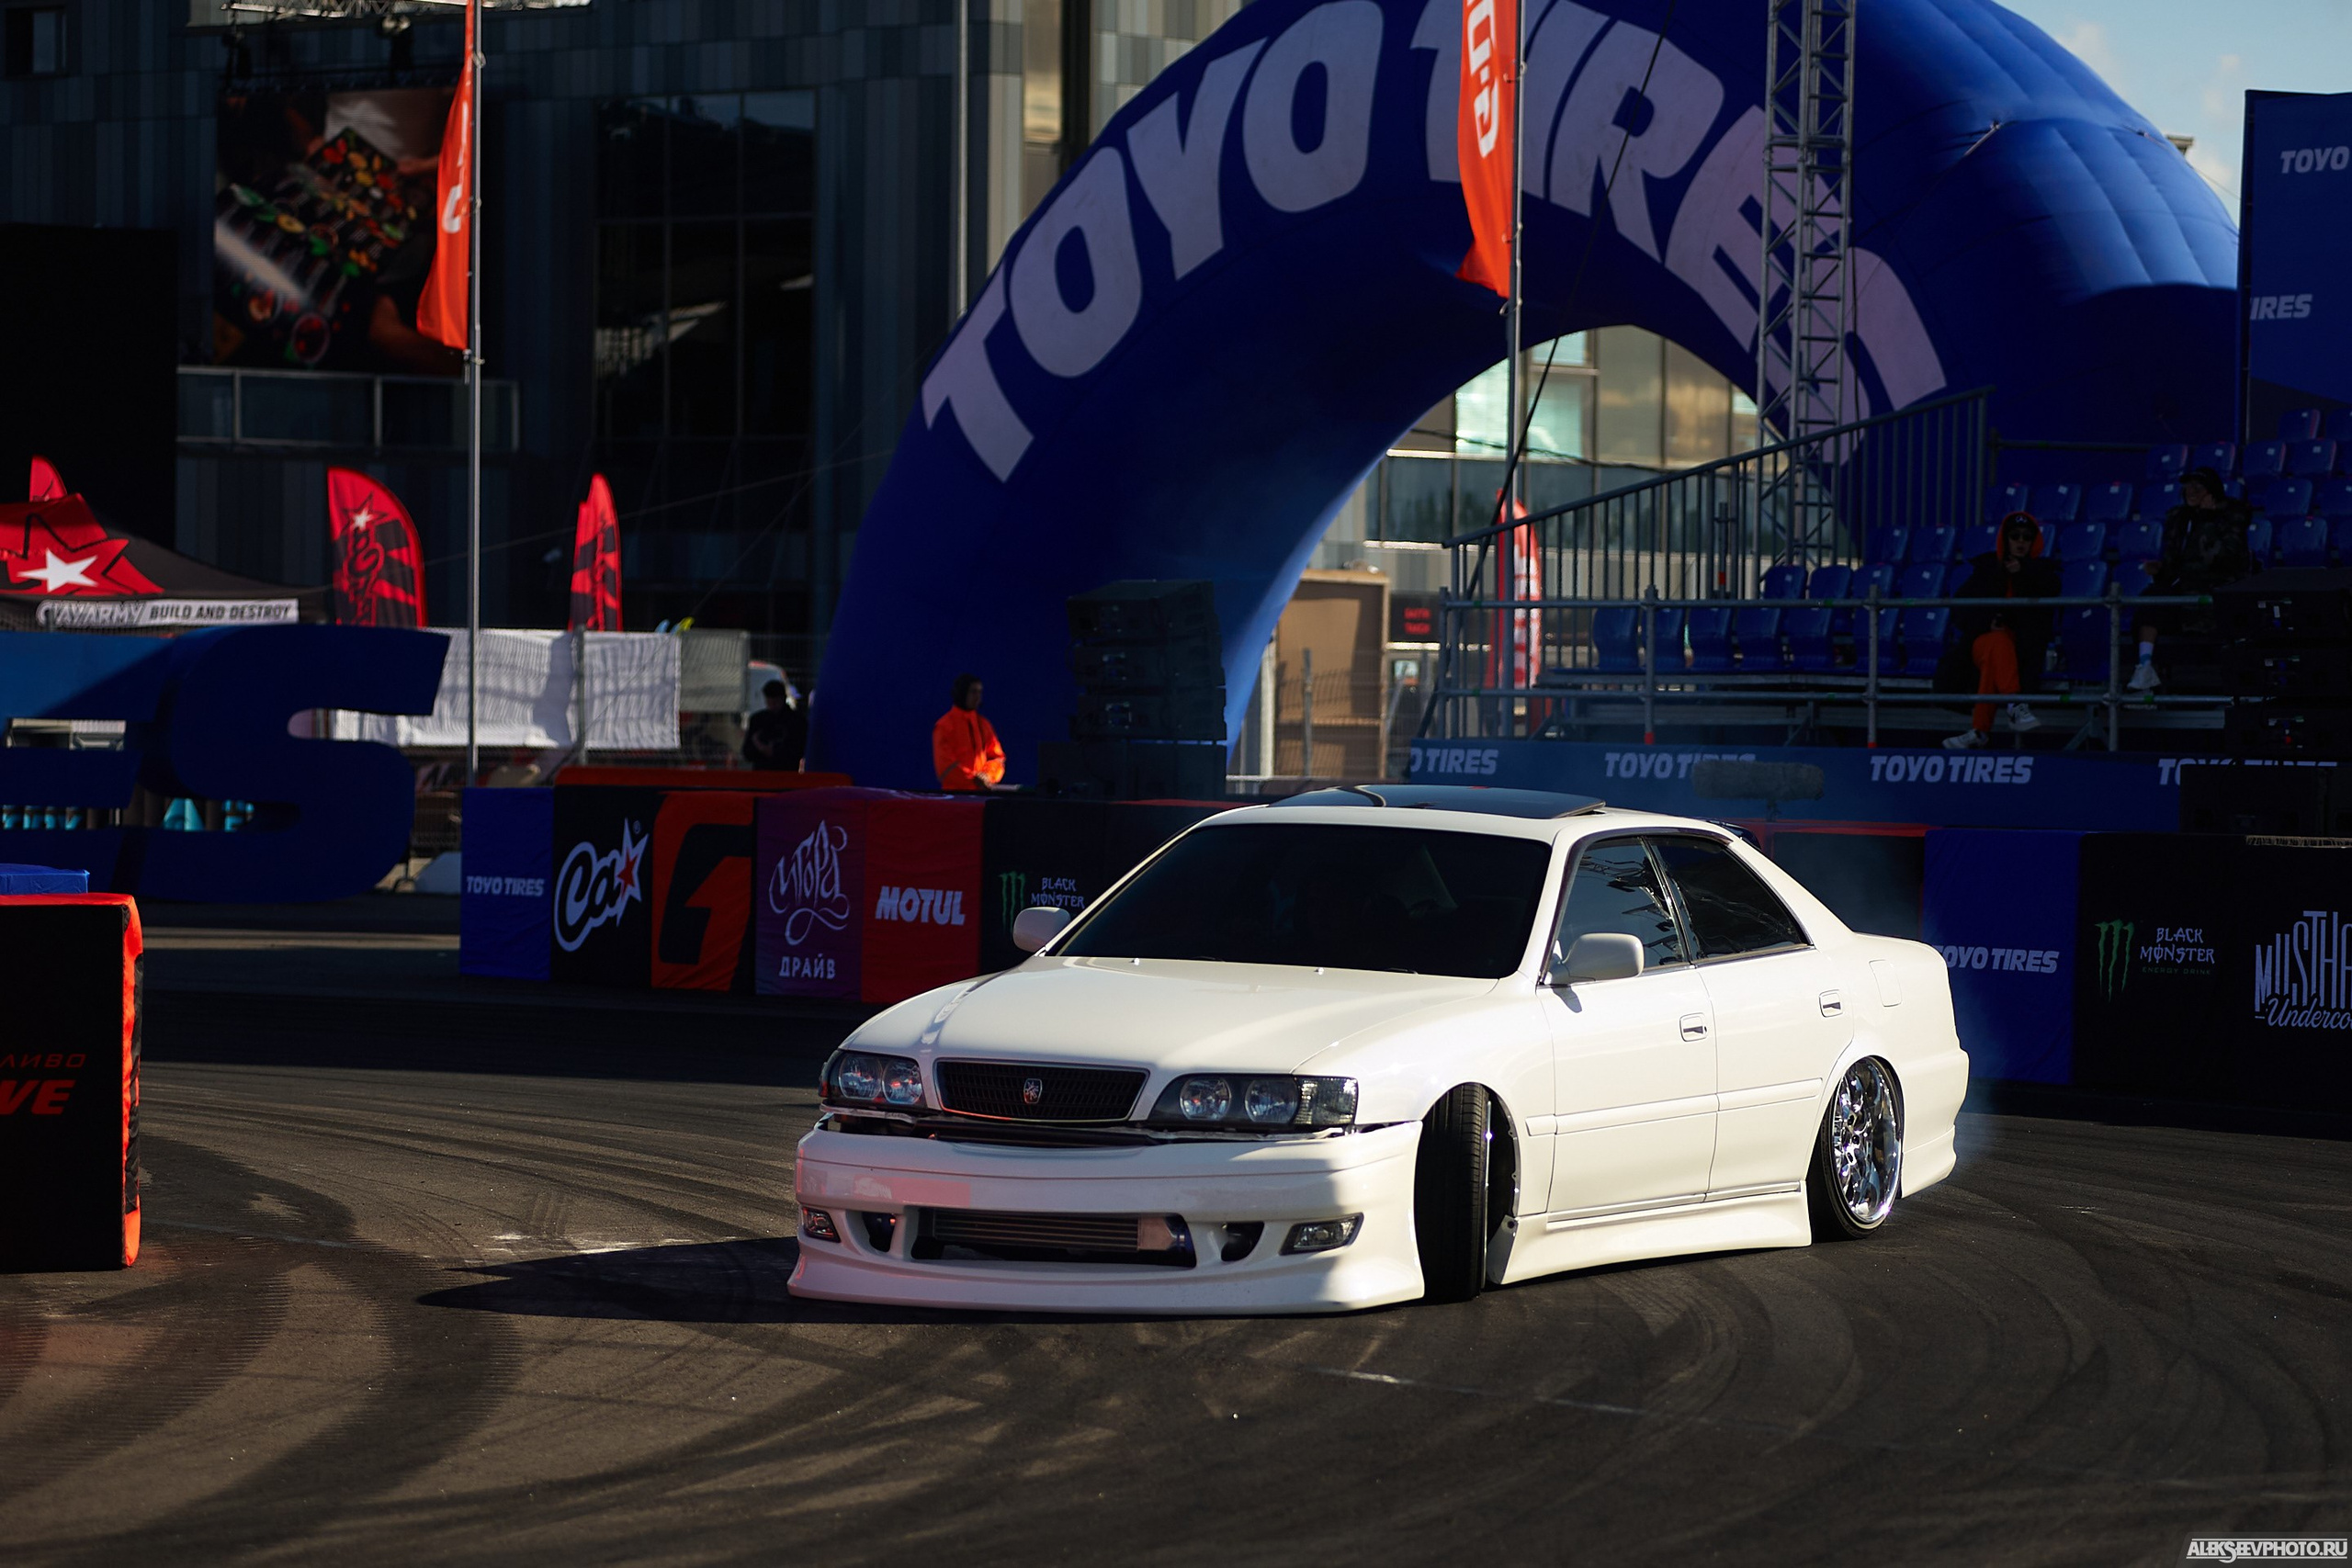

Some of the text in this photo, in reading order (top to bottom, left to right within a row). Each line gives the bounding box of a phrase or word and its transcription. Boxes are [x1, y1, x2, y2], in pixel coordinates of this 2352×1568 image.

[2279, 145, 2351, 175] TOYO
[922, 0, 1384, 482] TOYO
[2249, 293, 2313, 321] IRES
[150, 604, 192, 621] BUILD
[196, 604, 226, 621] AND
[229, 604, 291, 621] DESTROY
[1426, 747, 1499, 776] TIRES
[1604, 751, 1673, 780] TOYO
[1870, 754, 2035, 785] TOYO TIRES
[466, 874, 546, 897] TOYO TIRES
[1041, 876, 1078, 892] BLACK
[875, 885, 967, 926] MOTUL
[2155, 926, 2204, 943] BLACK
[777, 953, 837, 980] ДРАЙВ
[1991, 947, 2061, 974] TIRES
[2255, 909, 2352, 1012] MUSTHA
[2267, 998, 2352, 1030] Underco
[0, 1078, 77, 1116] VE
